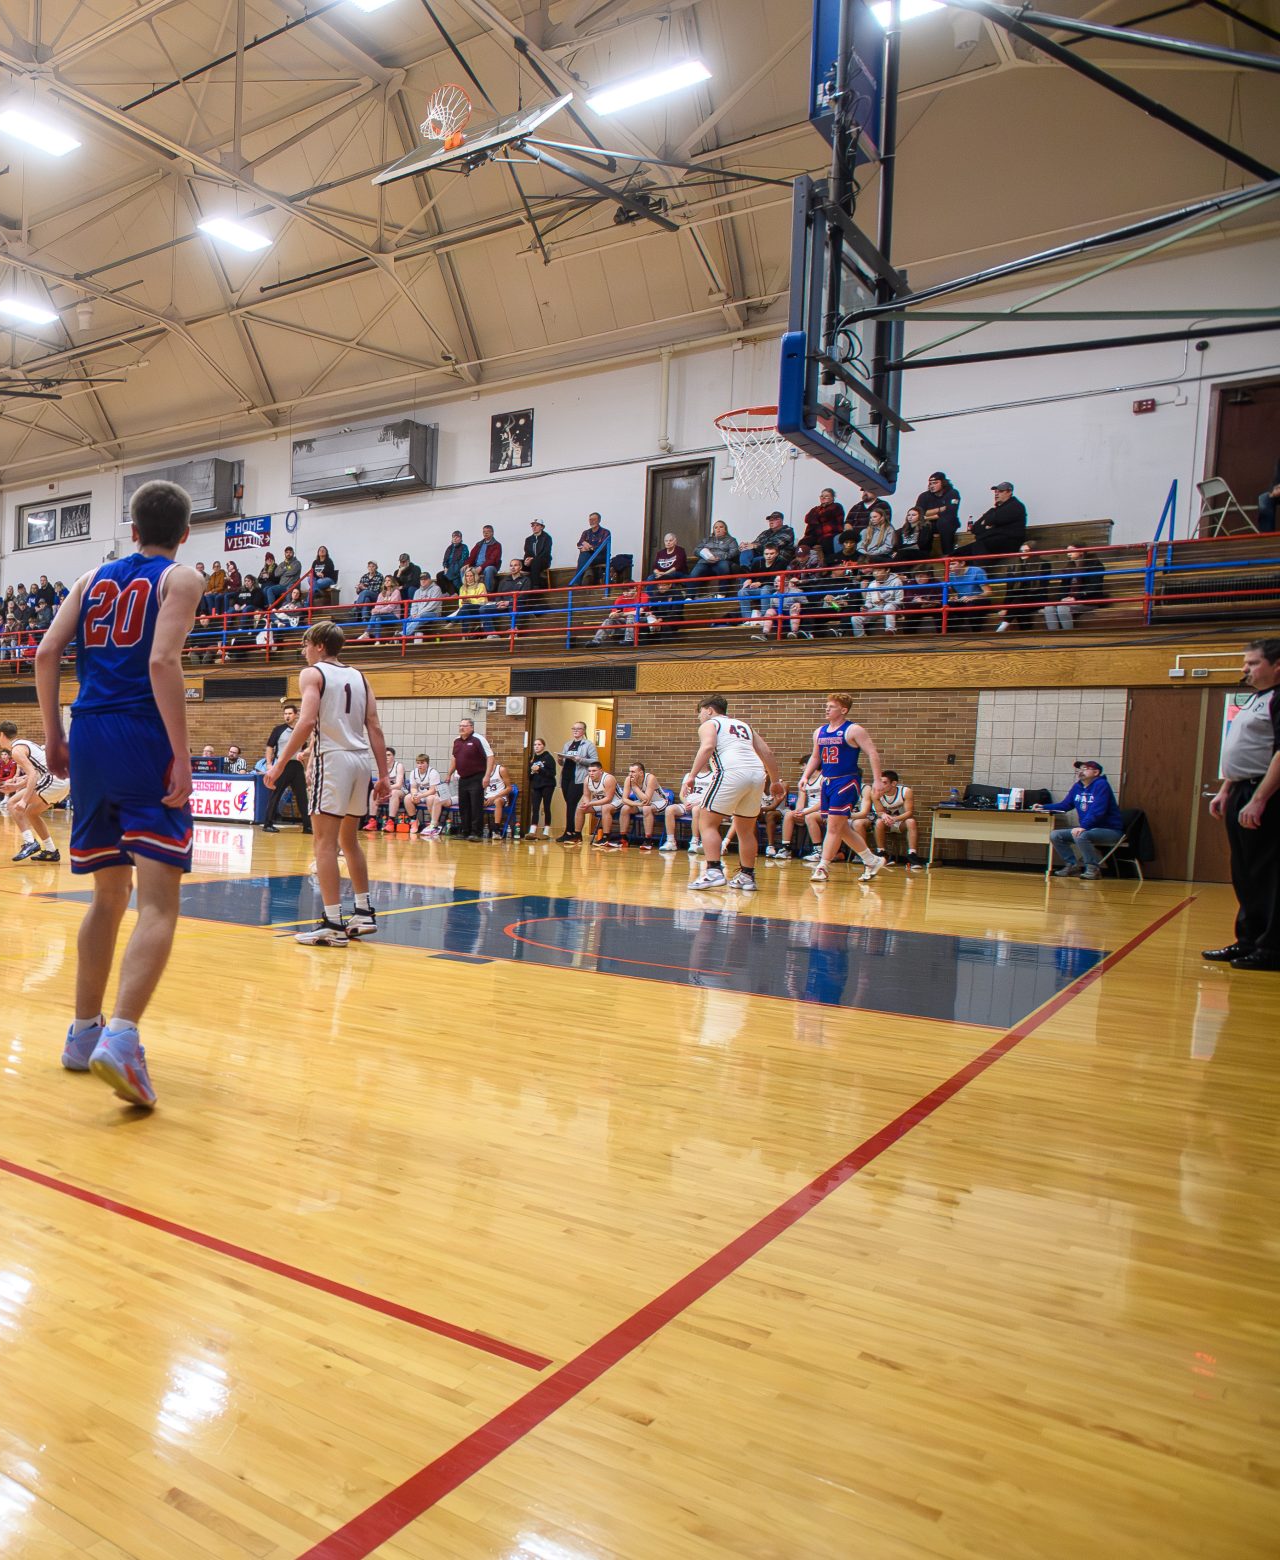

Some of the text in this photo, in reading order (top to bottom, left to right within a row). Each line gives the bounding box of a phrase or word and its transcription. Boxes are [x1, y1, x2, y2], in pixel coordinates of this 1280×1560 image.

[234, 519, 265, 534] HOME
[84, 577, 153, 649] 20
[344, 682, 352, 714] 1
[729, 724, 751, 740] 43
[821, 746, 839, 764] 42
[191, 781, 232, 793] CHISHOLM
[189, 799, 231, 816] REAKS
